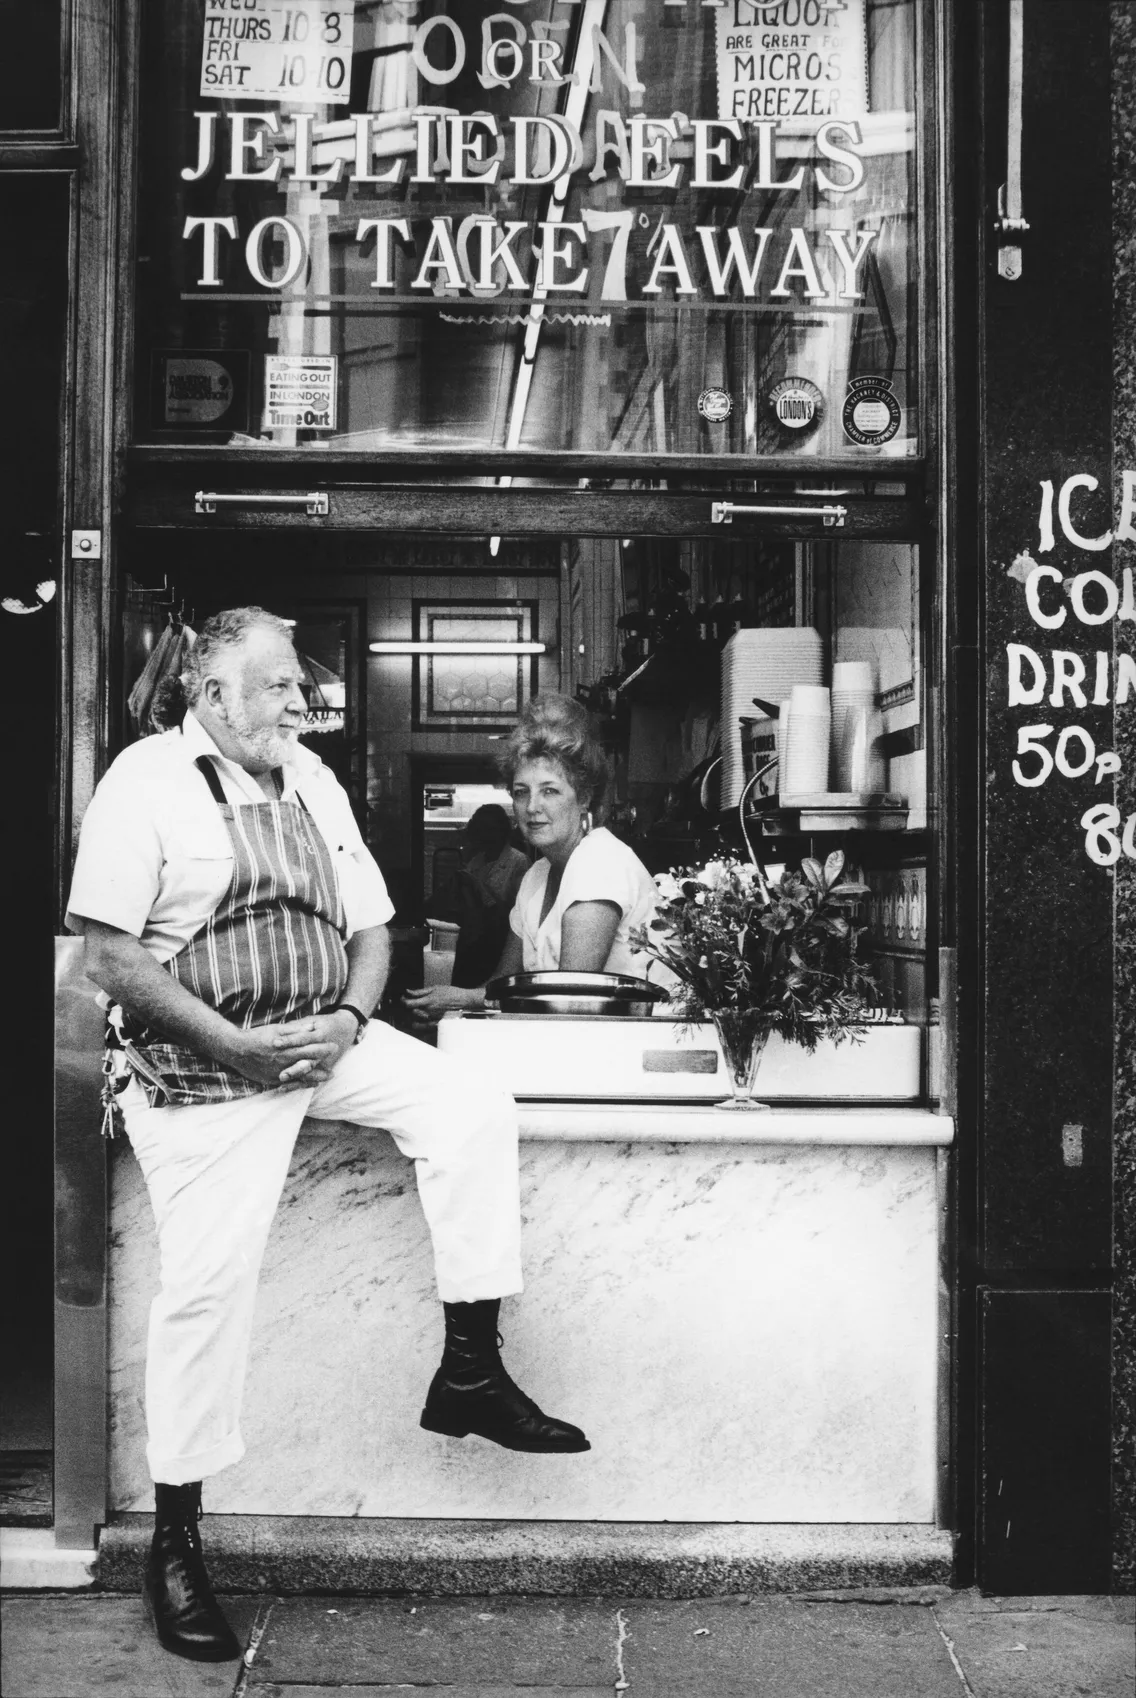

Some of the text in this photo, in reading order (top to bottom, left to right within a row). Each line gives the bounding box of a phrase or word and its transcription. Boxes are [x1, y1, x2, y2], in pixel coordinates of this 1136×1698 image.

[206, 17, 271, 40] THURS
[726, 35, 753, 49] ARE
[762, 34, 811, 48] GREAT
[206, 40, 240, 61] FRI
[486, 38, 564, 81] OR
[205, 64, 252, 85] SAT
[734, 52, 842, 82] MICROS
[180, 111, 866, 193] JELLIED EELS
[183, 215, 877, 299] TO TAKE AWAY
[270, 373, 331, 382] EATING OUT
[270, 391, 330, 400] IN LONDON
[850, 389, 875, 405] HACKNEY
[881, 392, 899, 417] DISTRICT
[269, 409, 330, 426] Time Out
[845, 421, 866, 443] CHAMBER
[873, 420, 898, 445] COMMERCE
[1025, 565, 1136, 630] COL
[1006, 643, 1136, 708] DRIN
[1011, 723, 1122, 788] 50p
